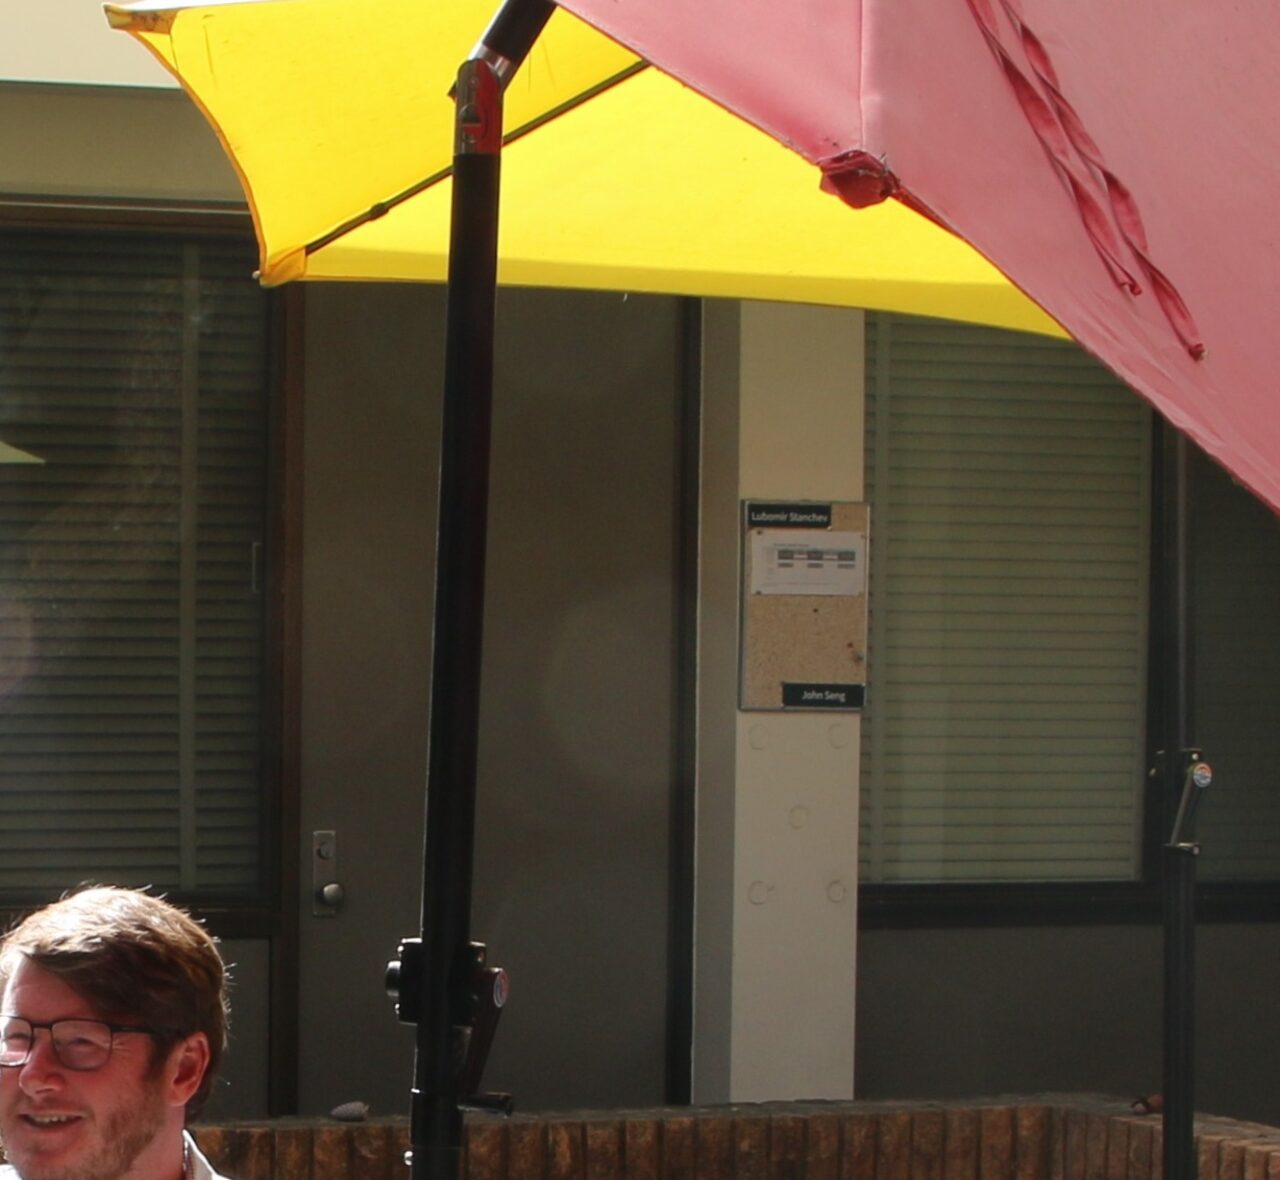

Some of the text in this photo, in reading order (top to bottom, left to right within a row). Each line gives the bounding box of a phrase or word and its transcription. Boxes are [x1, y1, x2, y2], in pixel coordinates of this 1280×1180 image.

[751, 511, 828, 522] Lubomir Stanchev
[802, 690, 846, 703] John Seng
